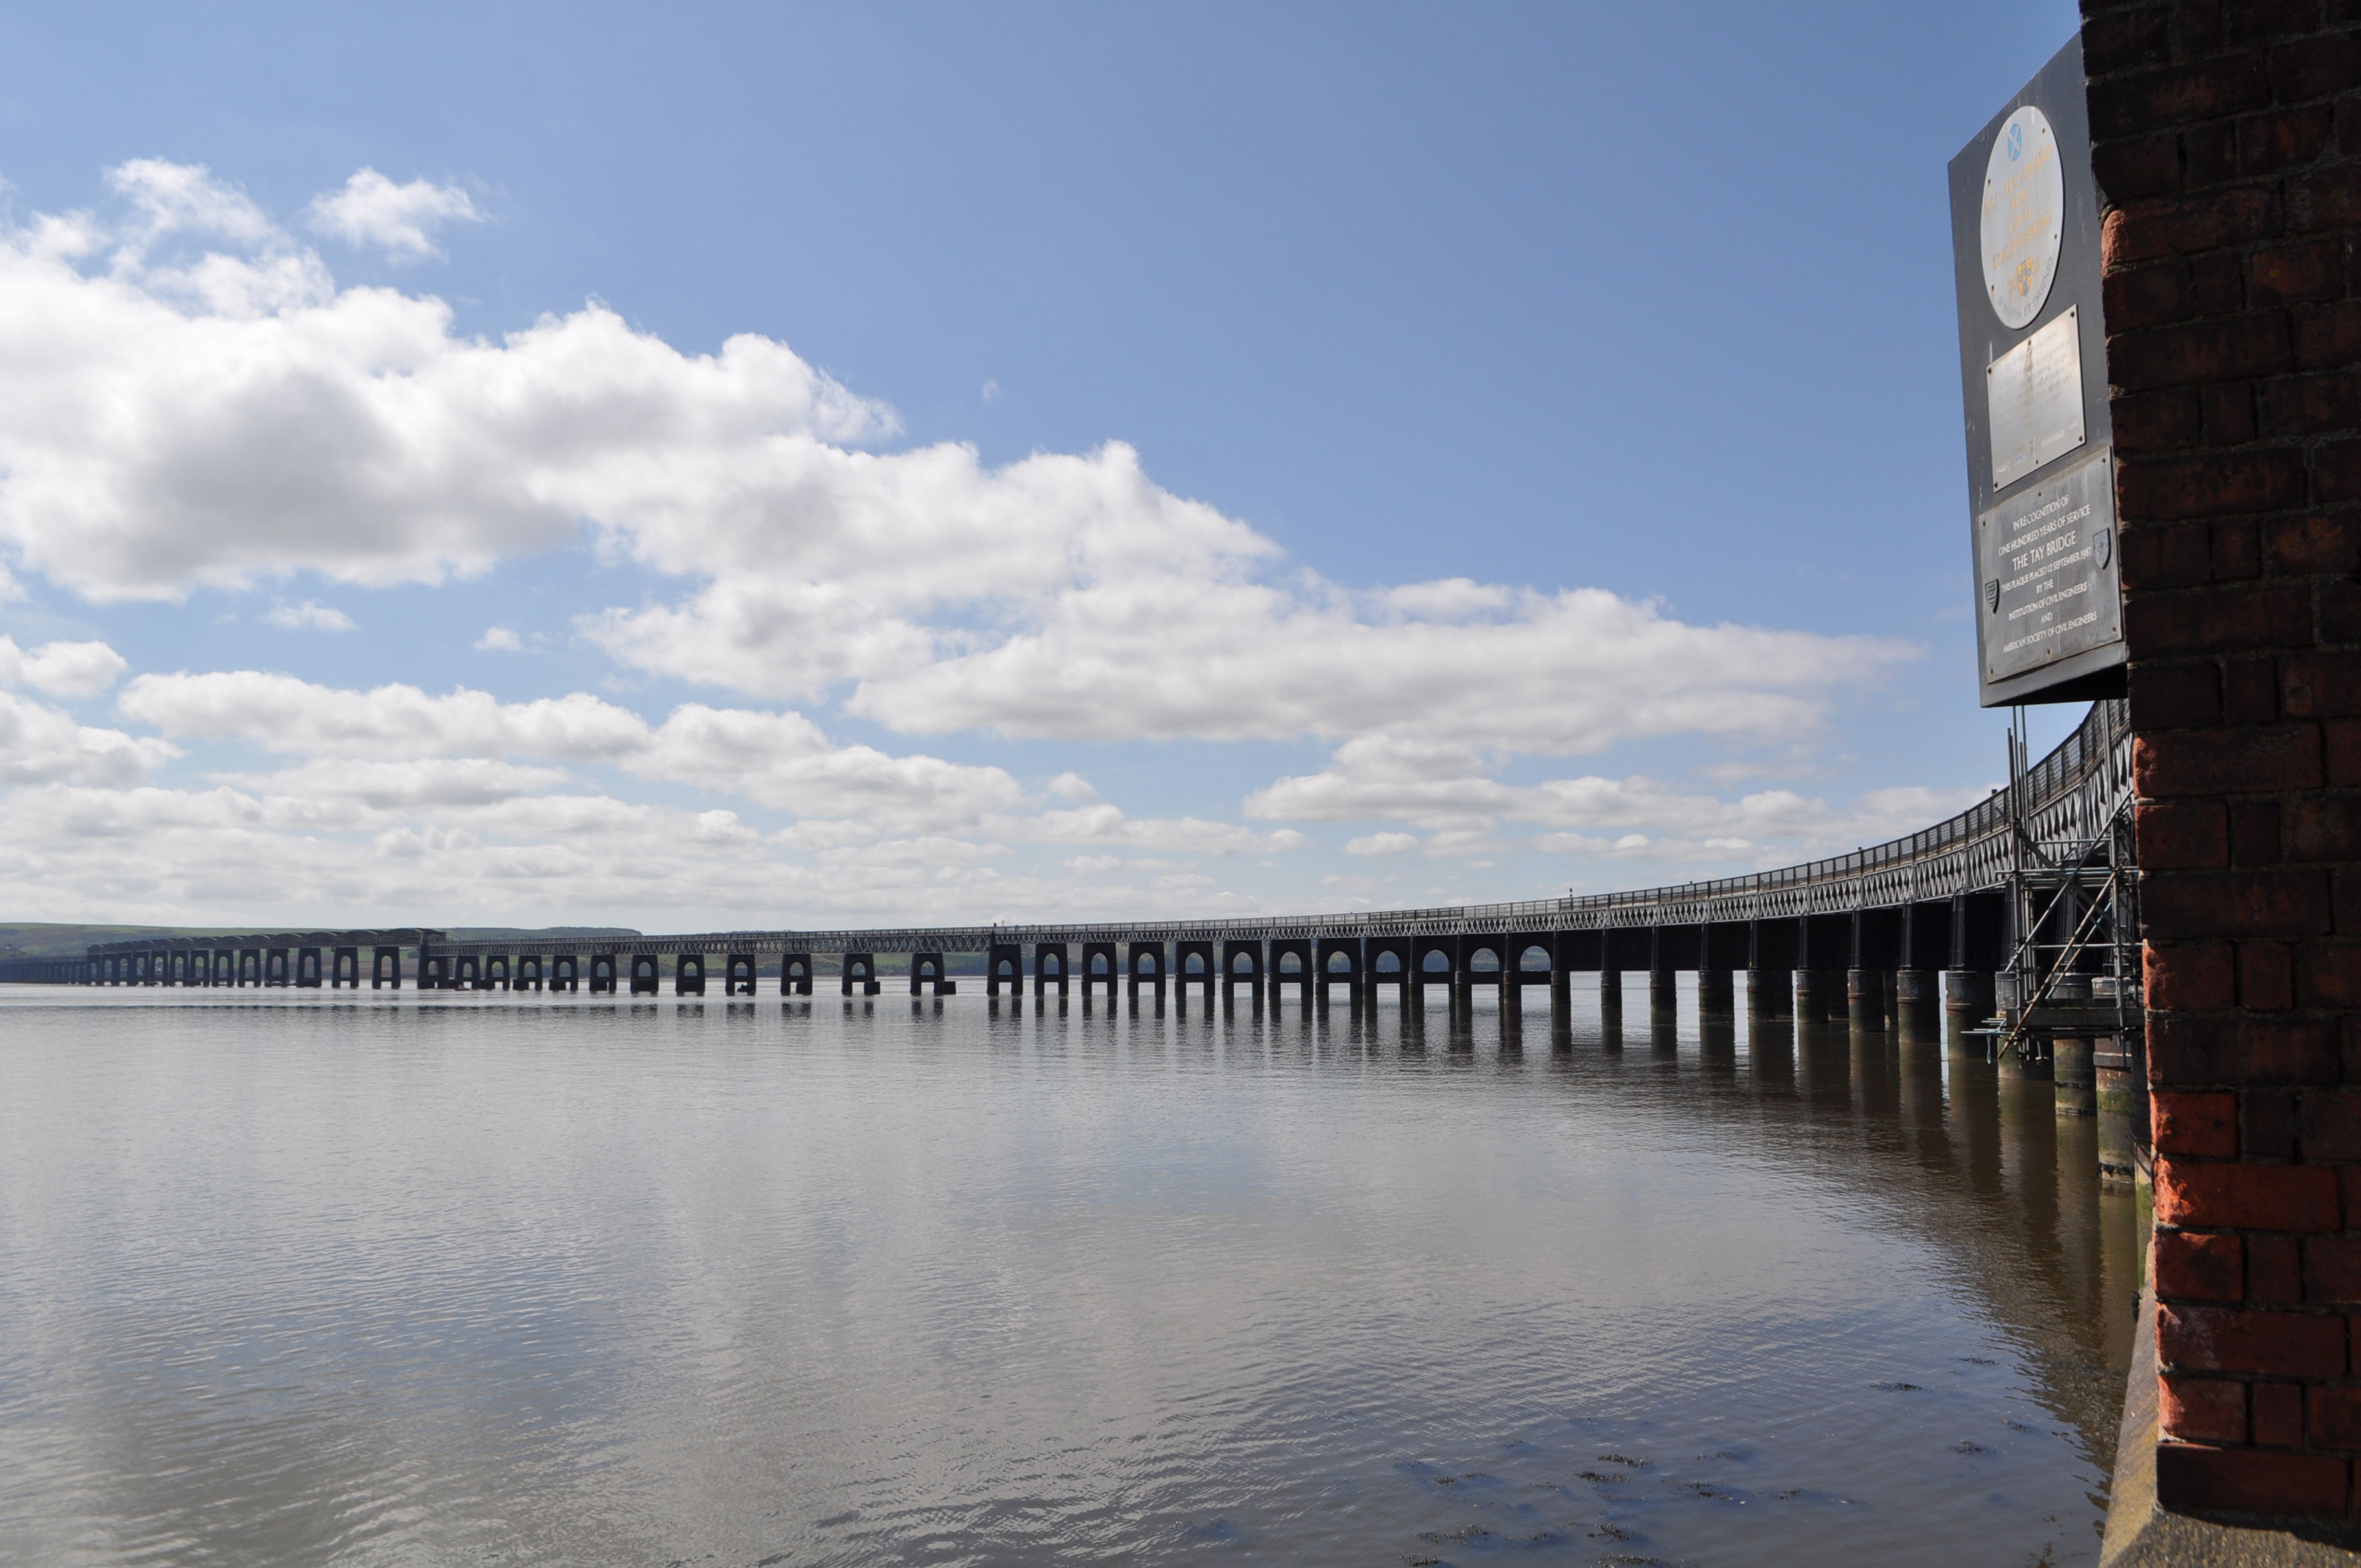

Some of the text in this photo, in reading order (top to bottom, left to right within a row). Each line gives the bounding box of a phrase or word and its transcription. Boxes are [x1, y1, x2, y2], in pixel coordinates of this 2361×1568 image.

[1998, 504, 2091, 556] ONE HUNDRED YEARS OF SERVICE
[2020, 500, 2061, 529] RECOGNITION
[2061, 494, 2069, 507] OF
[2001, 582, 2012, 593] THIS
[2012, 574, 2030, 589] PLAQUE
[2029, 566, 2047, 581] PLACED
[2081, 546, 2092, 559] 1987
[2012, 530, 2077, 571] THE TAY BRIDGE
[2009, 581, 2087, 621] INSTITUTION OF CIVIL ENGINEERS
[2036, 578, 2053, 594] BY THE
[2003, 611, 2097, 653] AMERICAN SOCIETY OF CIVIL ENGINEERS
[2041, 612, 2053, 623] AND
